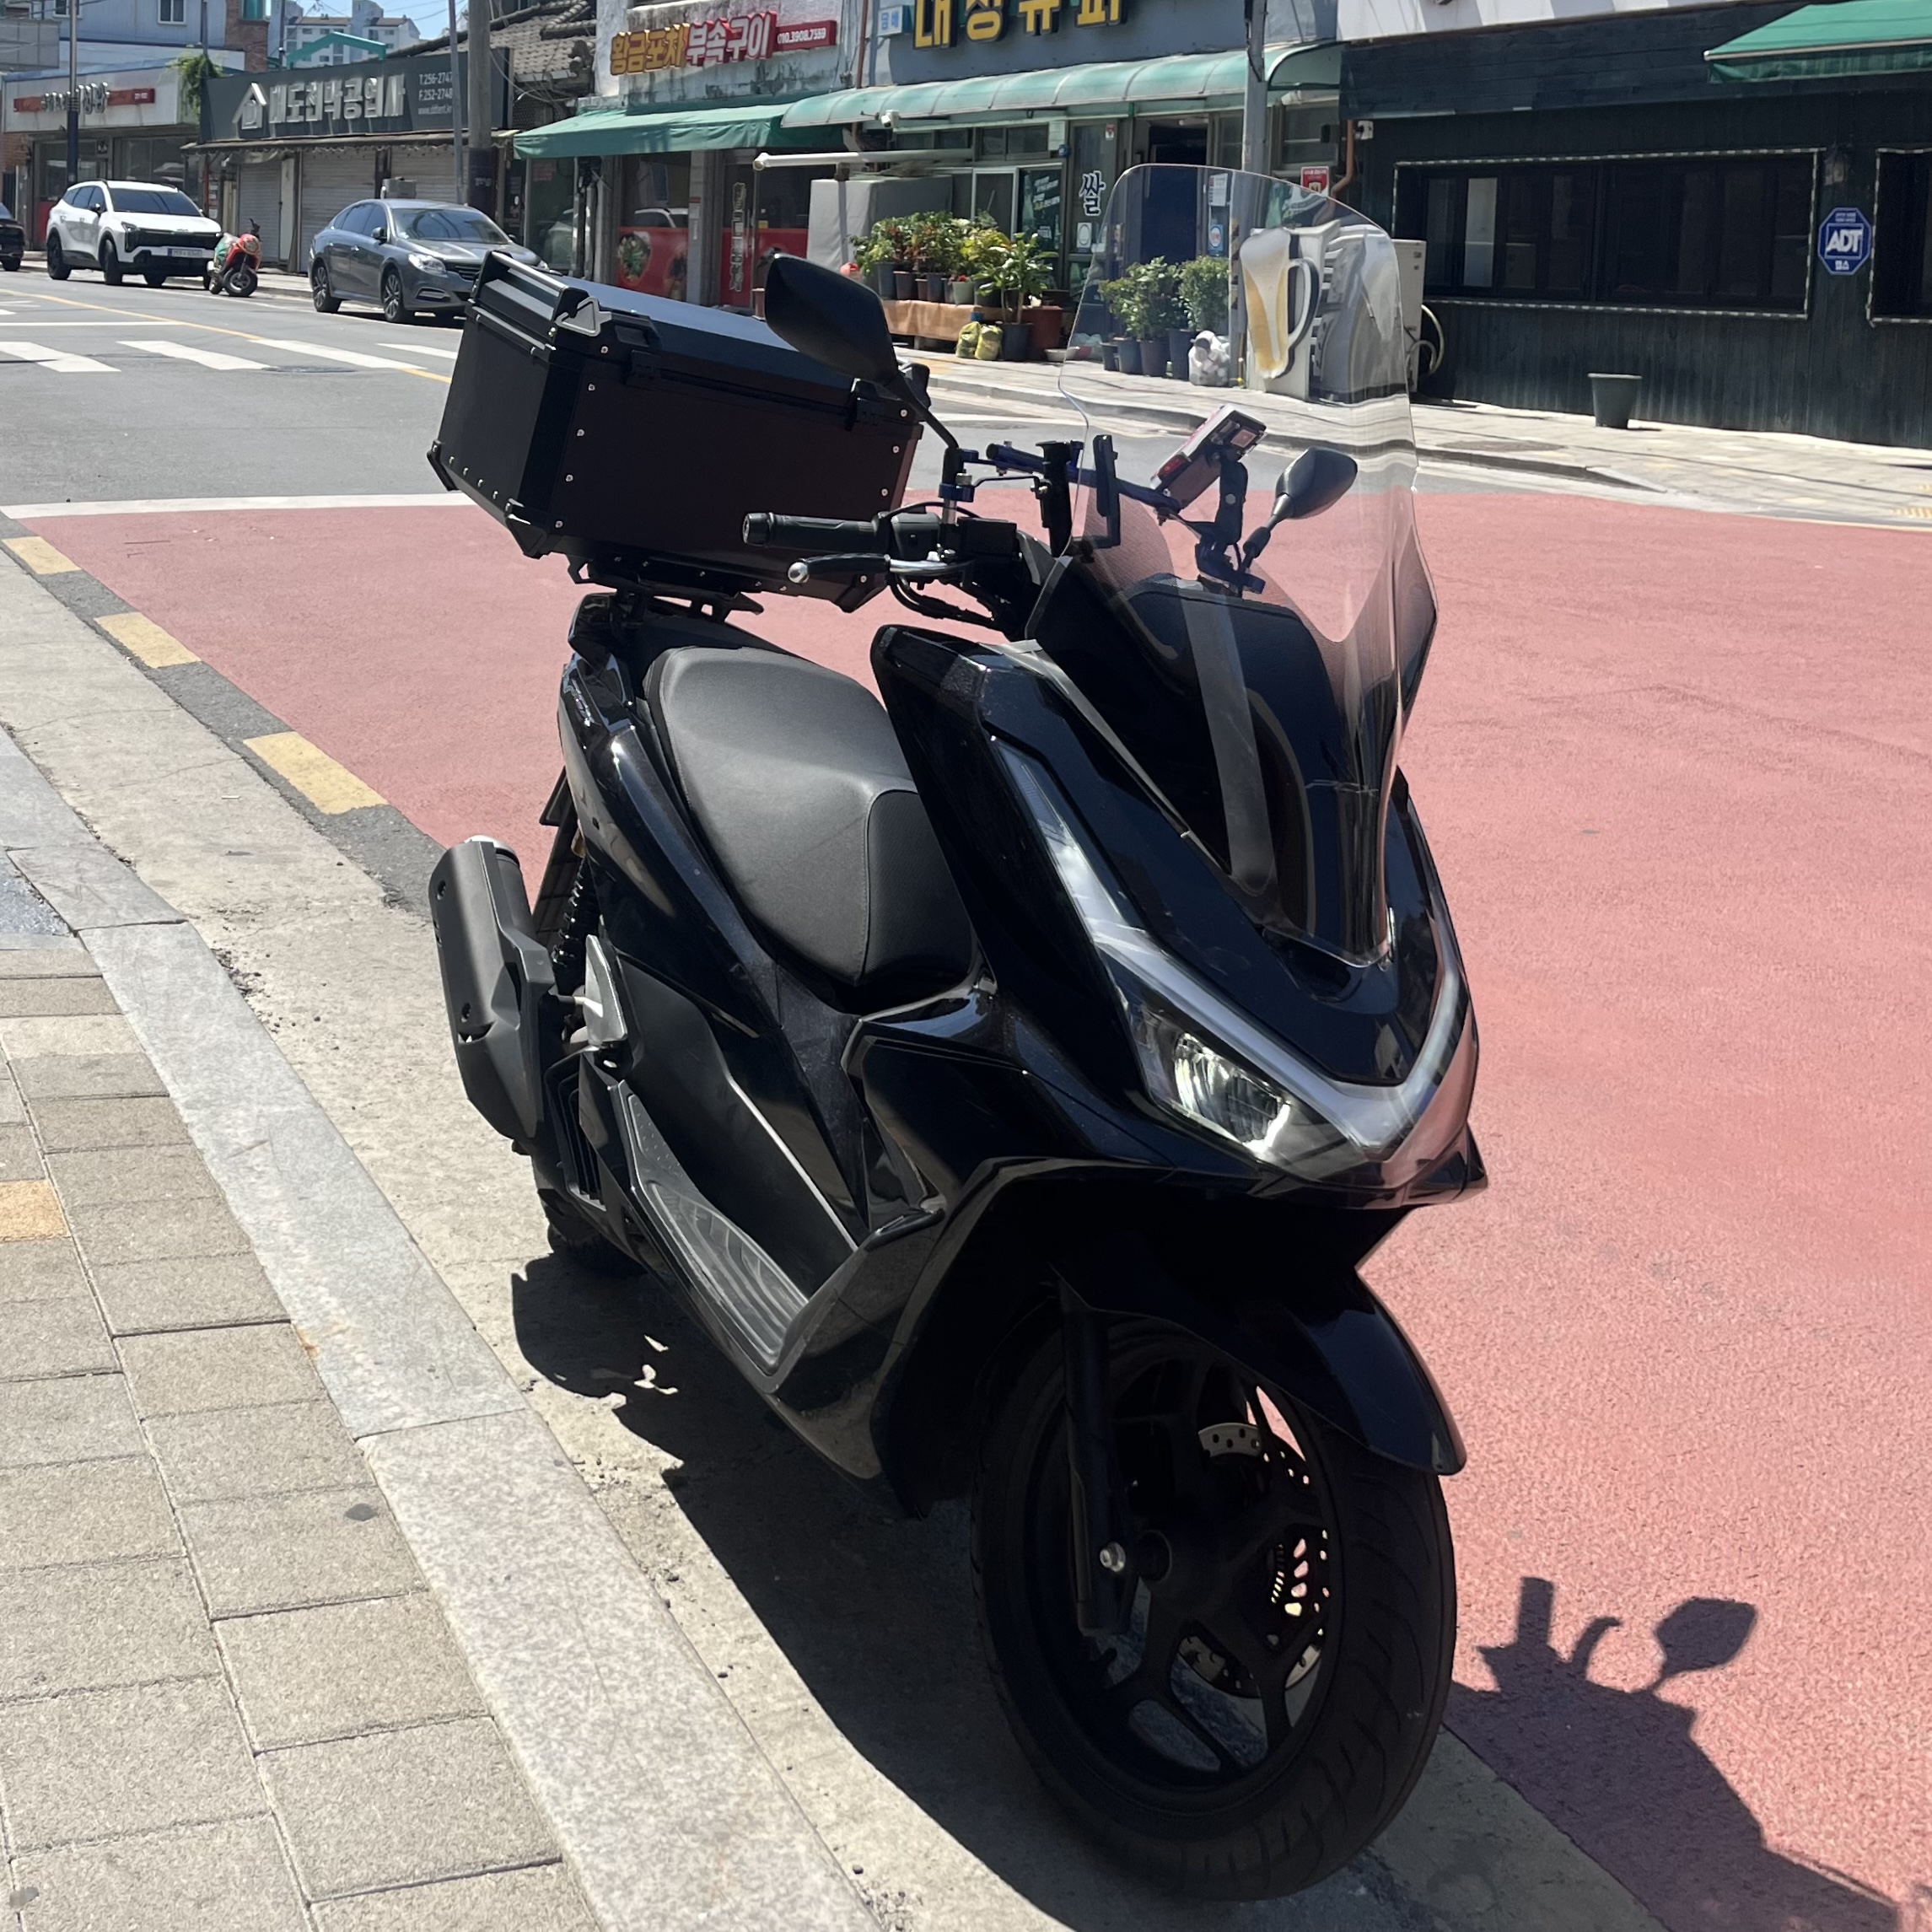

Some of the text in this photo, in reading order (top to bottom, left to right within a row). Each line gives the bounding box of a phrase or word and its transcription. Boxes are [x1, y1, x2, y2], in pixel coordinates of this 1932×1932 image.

[611, 12, 777, 75] 황금포차 부속구이
[1079, 170, 1106, 216] 쌀
[1826, 229, 1864, 253] ADT
